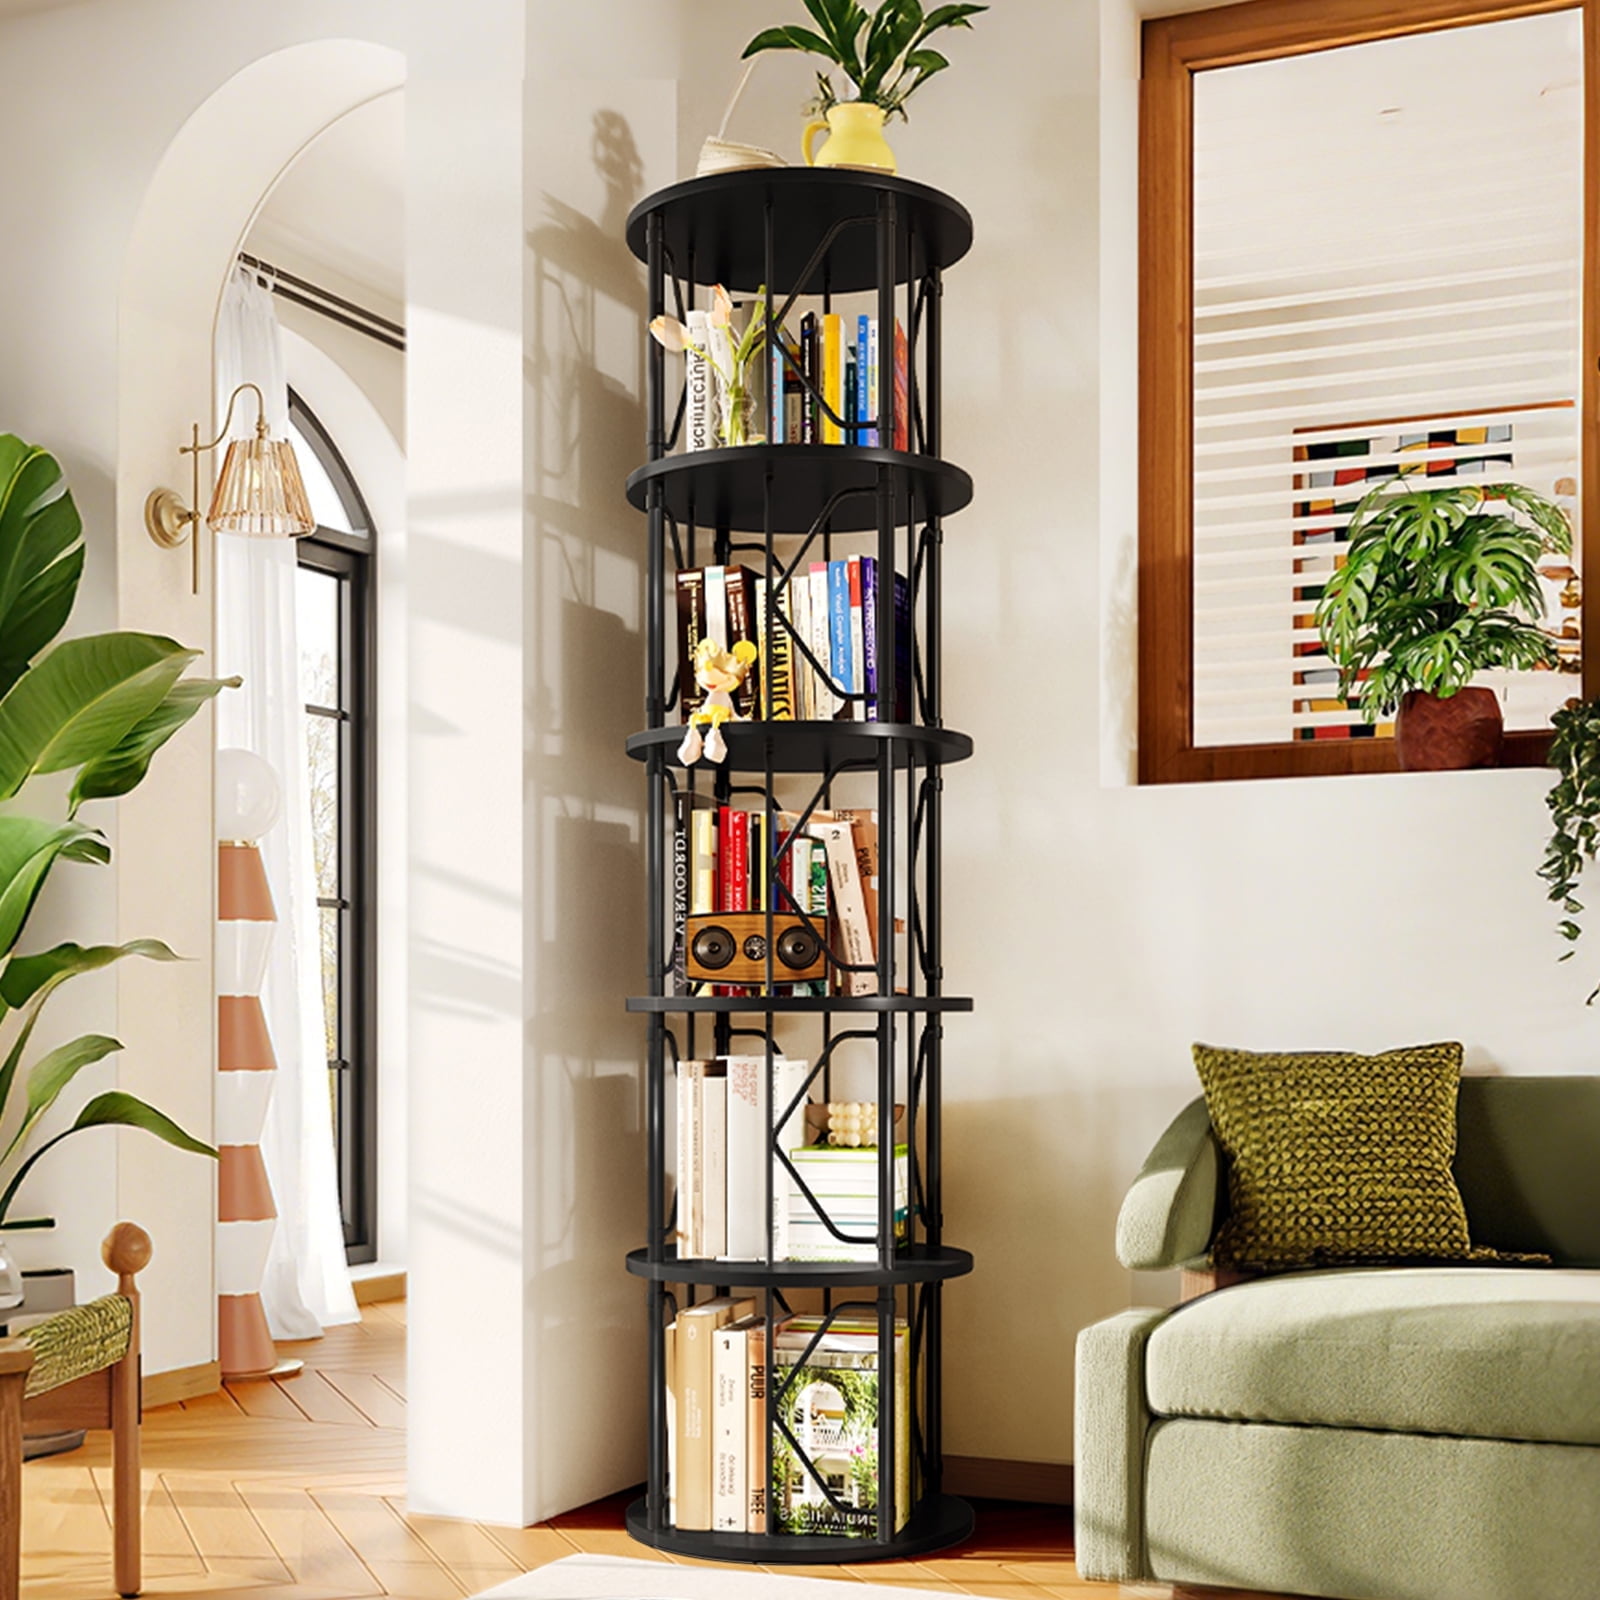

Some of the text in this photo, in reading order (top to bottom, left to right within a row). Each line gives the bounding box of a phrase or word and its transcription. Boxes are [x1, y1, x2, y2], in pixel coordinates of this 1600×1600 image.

[764, 592, 790, 720] HEMATICS
[831, 829, 841, 840] 2
[750, 1364, 765, 1400] PUUR
[750, 1487, 765, 1516] THEE
